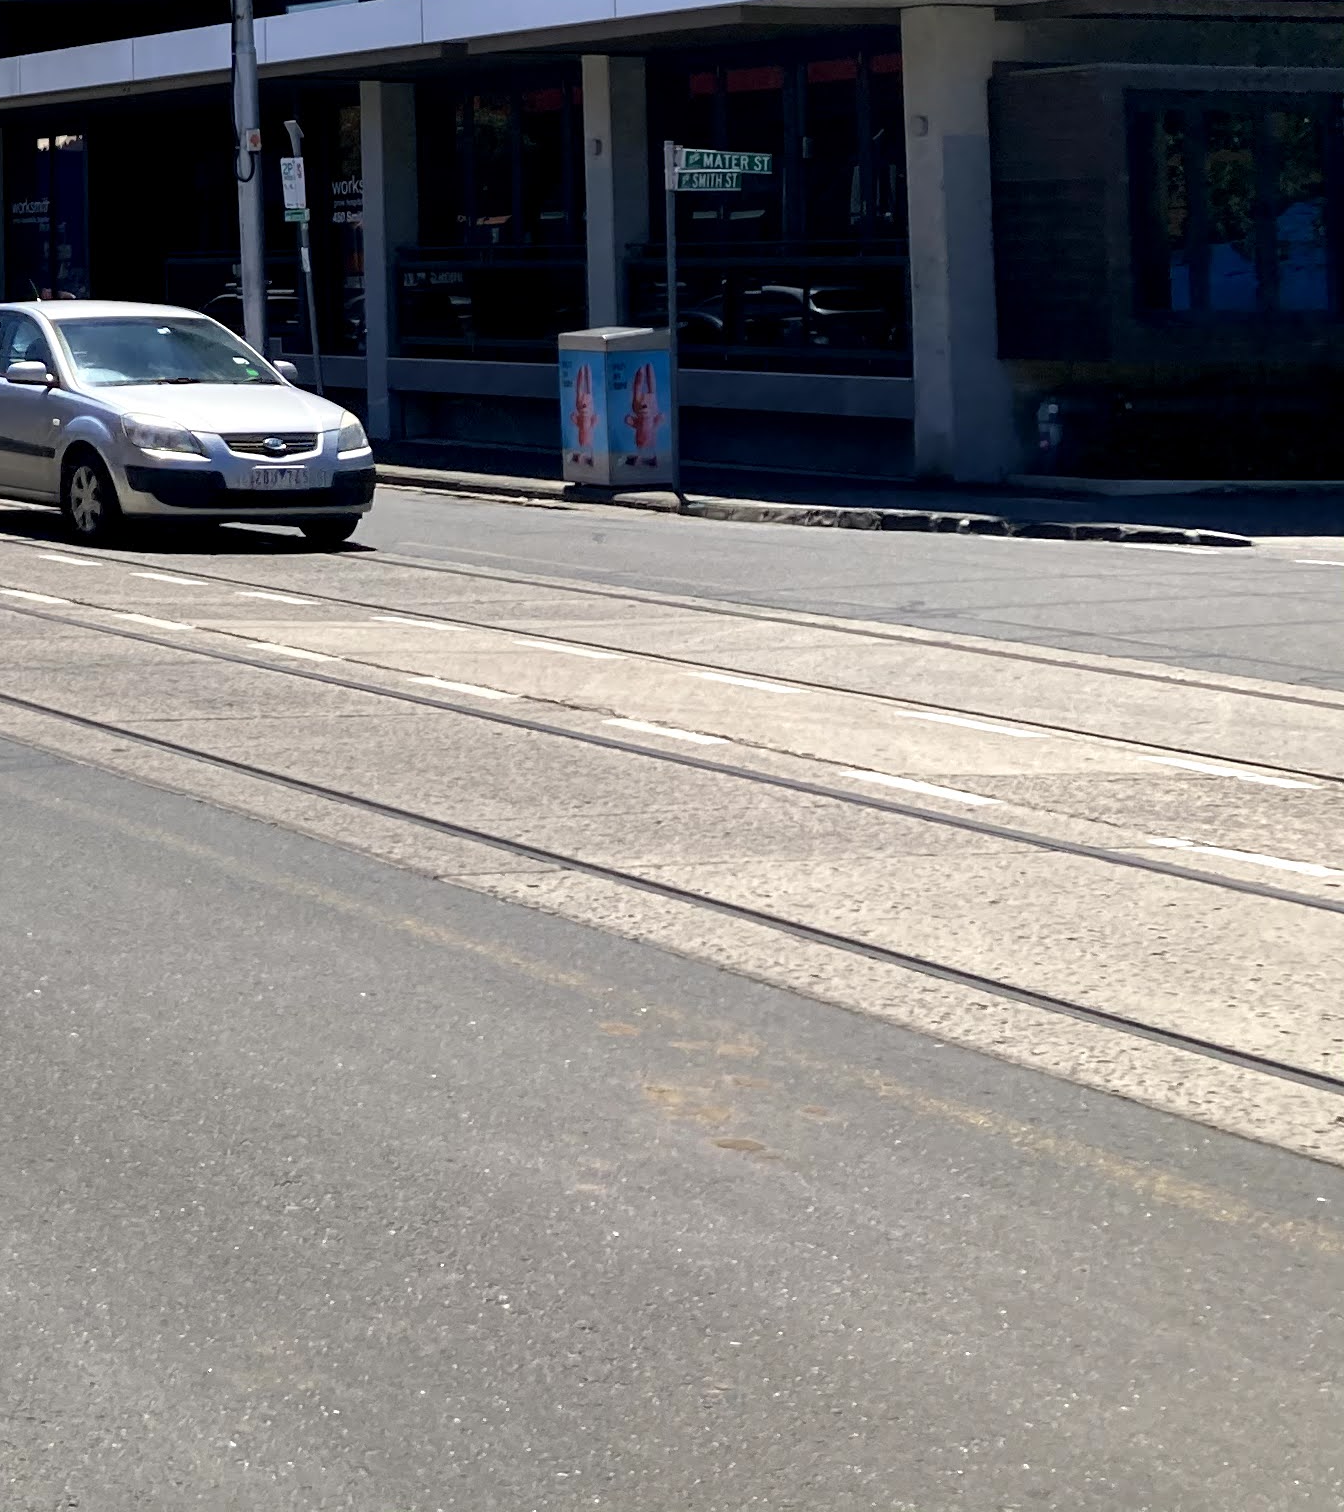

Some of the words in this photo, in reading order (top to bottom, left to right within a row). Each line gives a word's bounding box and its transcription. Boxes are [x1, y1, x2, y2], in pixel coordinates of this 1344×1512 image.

[703, 153, 749, 170] MATER
[753, 155, 771, 171] ST
[692, 172, 723, 188] SMITH
[725, 172, 738, 188] ST
